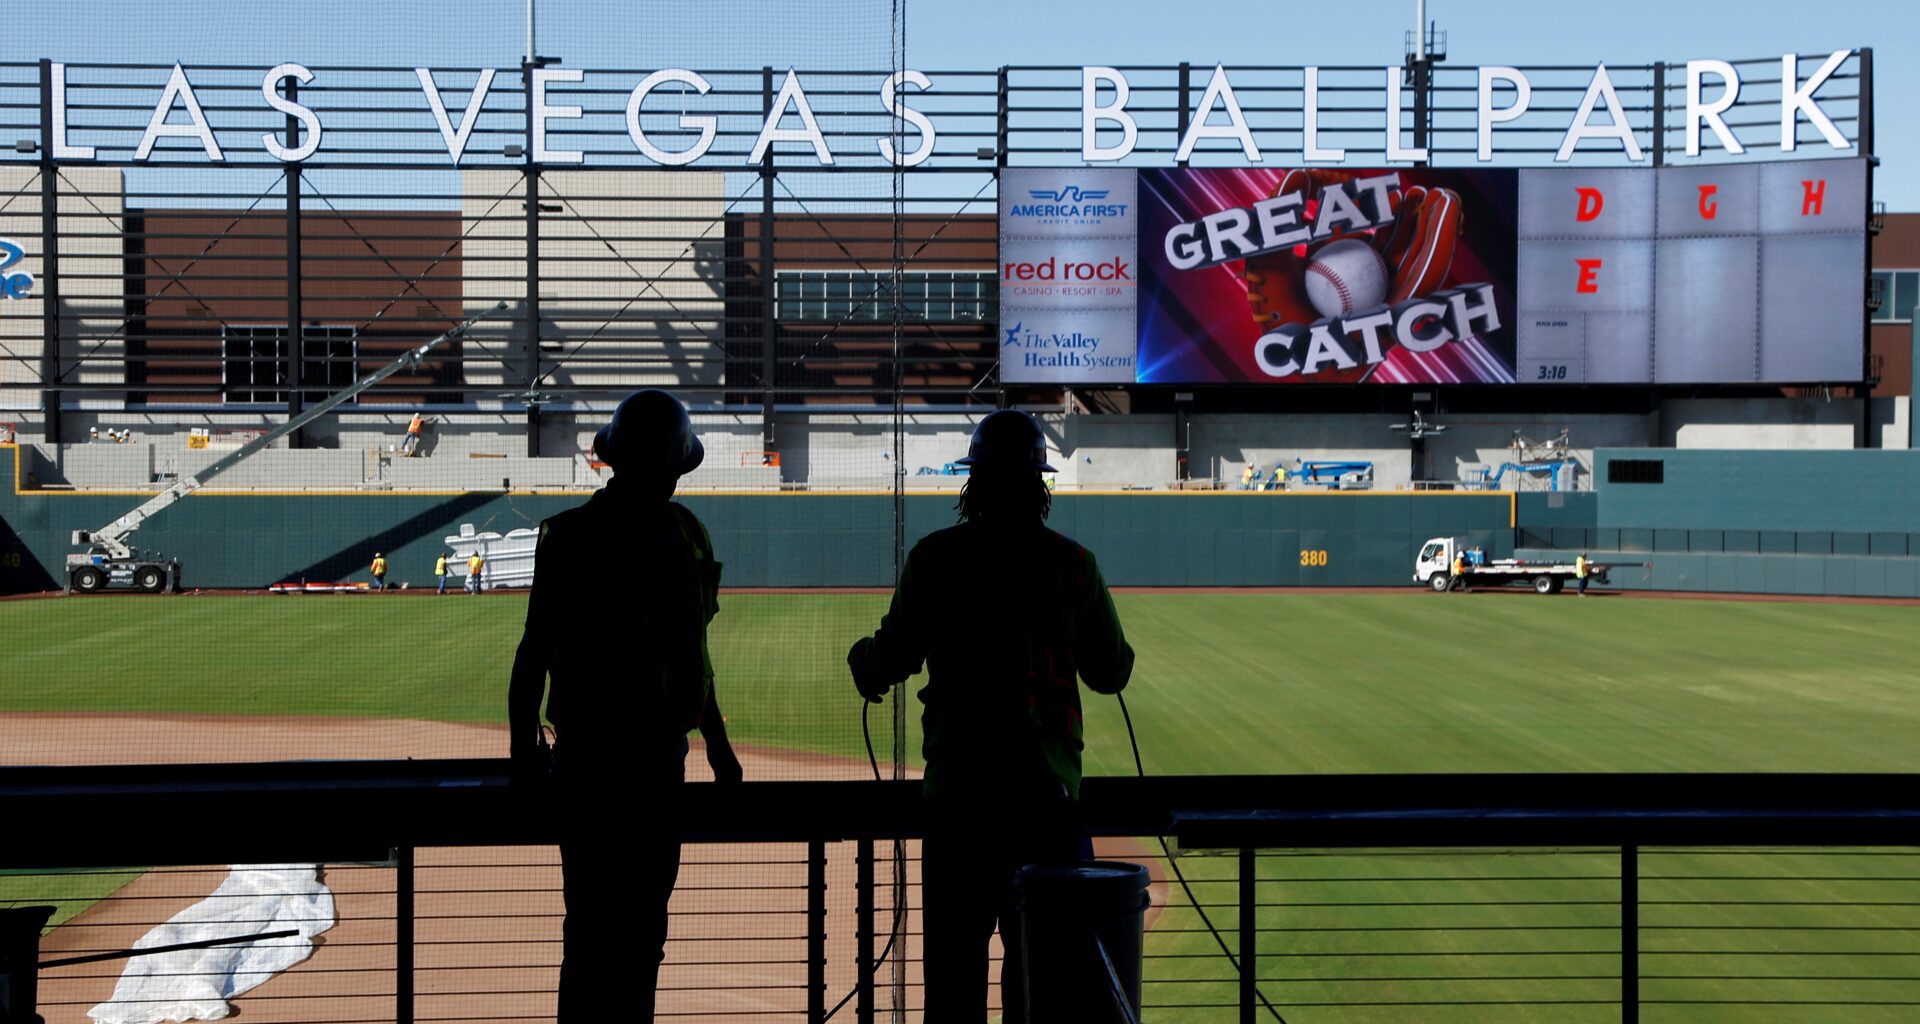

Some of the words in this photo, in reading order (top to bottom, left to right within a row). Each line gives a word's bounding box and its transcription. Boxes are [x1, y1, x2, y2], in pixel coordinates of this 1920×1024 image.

[51, 60, 323, 162] LAS
[415, 66, 937, 167] VEGAS
[1081, 49, 1854, 163] BALLPARK
[1574, 187, 1604, 222] D
[1801, 179, 1826, 216] H
[1010, 204, 1080, 217] AMERICA
[1083, 204, 1128, 217] FIRST
[1164, 172, 1401, 270] GREAT
[1004, 256, 1055, 280] red
[1064, 256, 1131, 280] rock
[1575, 259, 1602, 294] E
[1013, 287, 1053, 296] CASINO
[1062, 287, 1097, 296] RESORT
[1105, 287, 1122, 296] SPA
[1254, 283, 1501, 377] CATCH
[1024, 333, 1051, 348] The
[1052, 333, 1100, 352] Valley
[1025, 352, 1080, 367] Health
[1081, 353, 1132, 371] System
[1537, 365, 1567, 380] 3:18
[1300, 550, 1328, 567] 380
